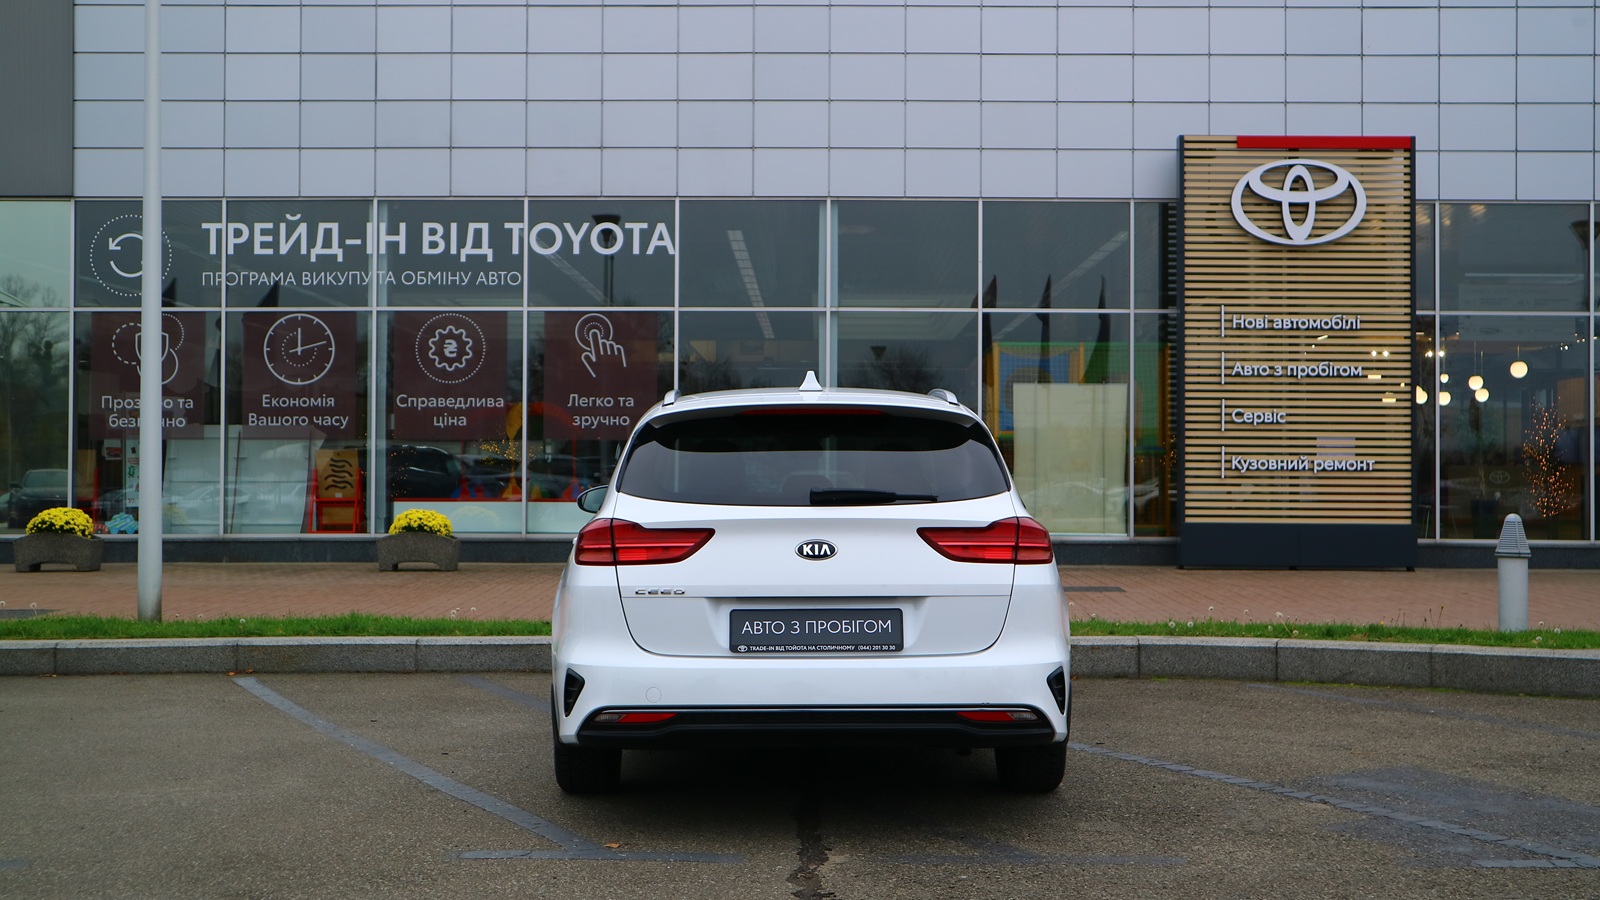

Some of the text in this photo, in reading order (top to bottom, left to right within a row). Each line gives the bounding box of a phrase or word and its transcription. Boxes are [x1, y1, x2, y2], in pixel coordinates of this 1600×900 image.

[201, 213, 676, 263] ТРЕЙД-ІН ВІД TOYOTA
[202, 270, 521, 286] ПРОГРАМА ВИКУПУ ТА ОБМІНУ АВТО
[1232, 314, 1361, 331] Нові автомобілі
[1231, 361, 1363, 379] Авто з пробігом
[101, 395, 194, 412] Прозо та
[261, 393, 335, 408] Економія
[396, 394, 504, 410] Справедлива
[567, 394, 634, 408] Легко та
[109, 413, 186, 428] безно
[248, 413, 349, 430] Вашого часу
[433, 412, 467, 429] ціна
[572, 415, 630, 429] зручно
[1231, 408, 1287, 426] Сервіс
[1231, 455, 1376, 474] Кузовний ремонт
[802, 543, 831, 556] KIA
[635, 588, 686, 596] CEED
[741, 619, 893, 636] АВТО З ПРОБІГОМ
